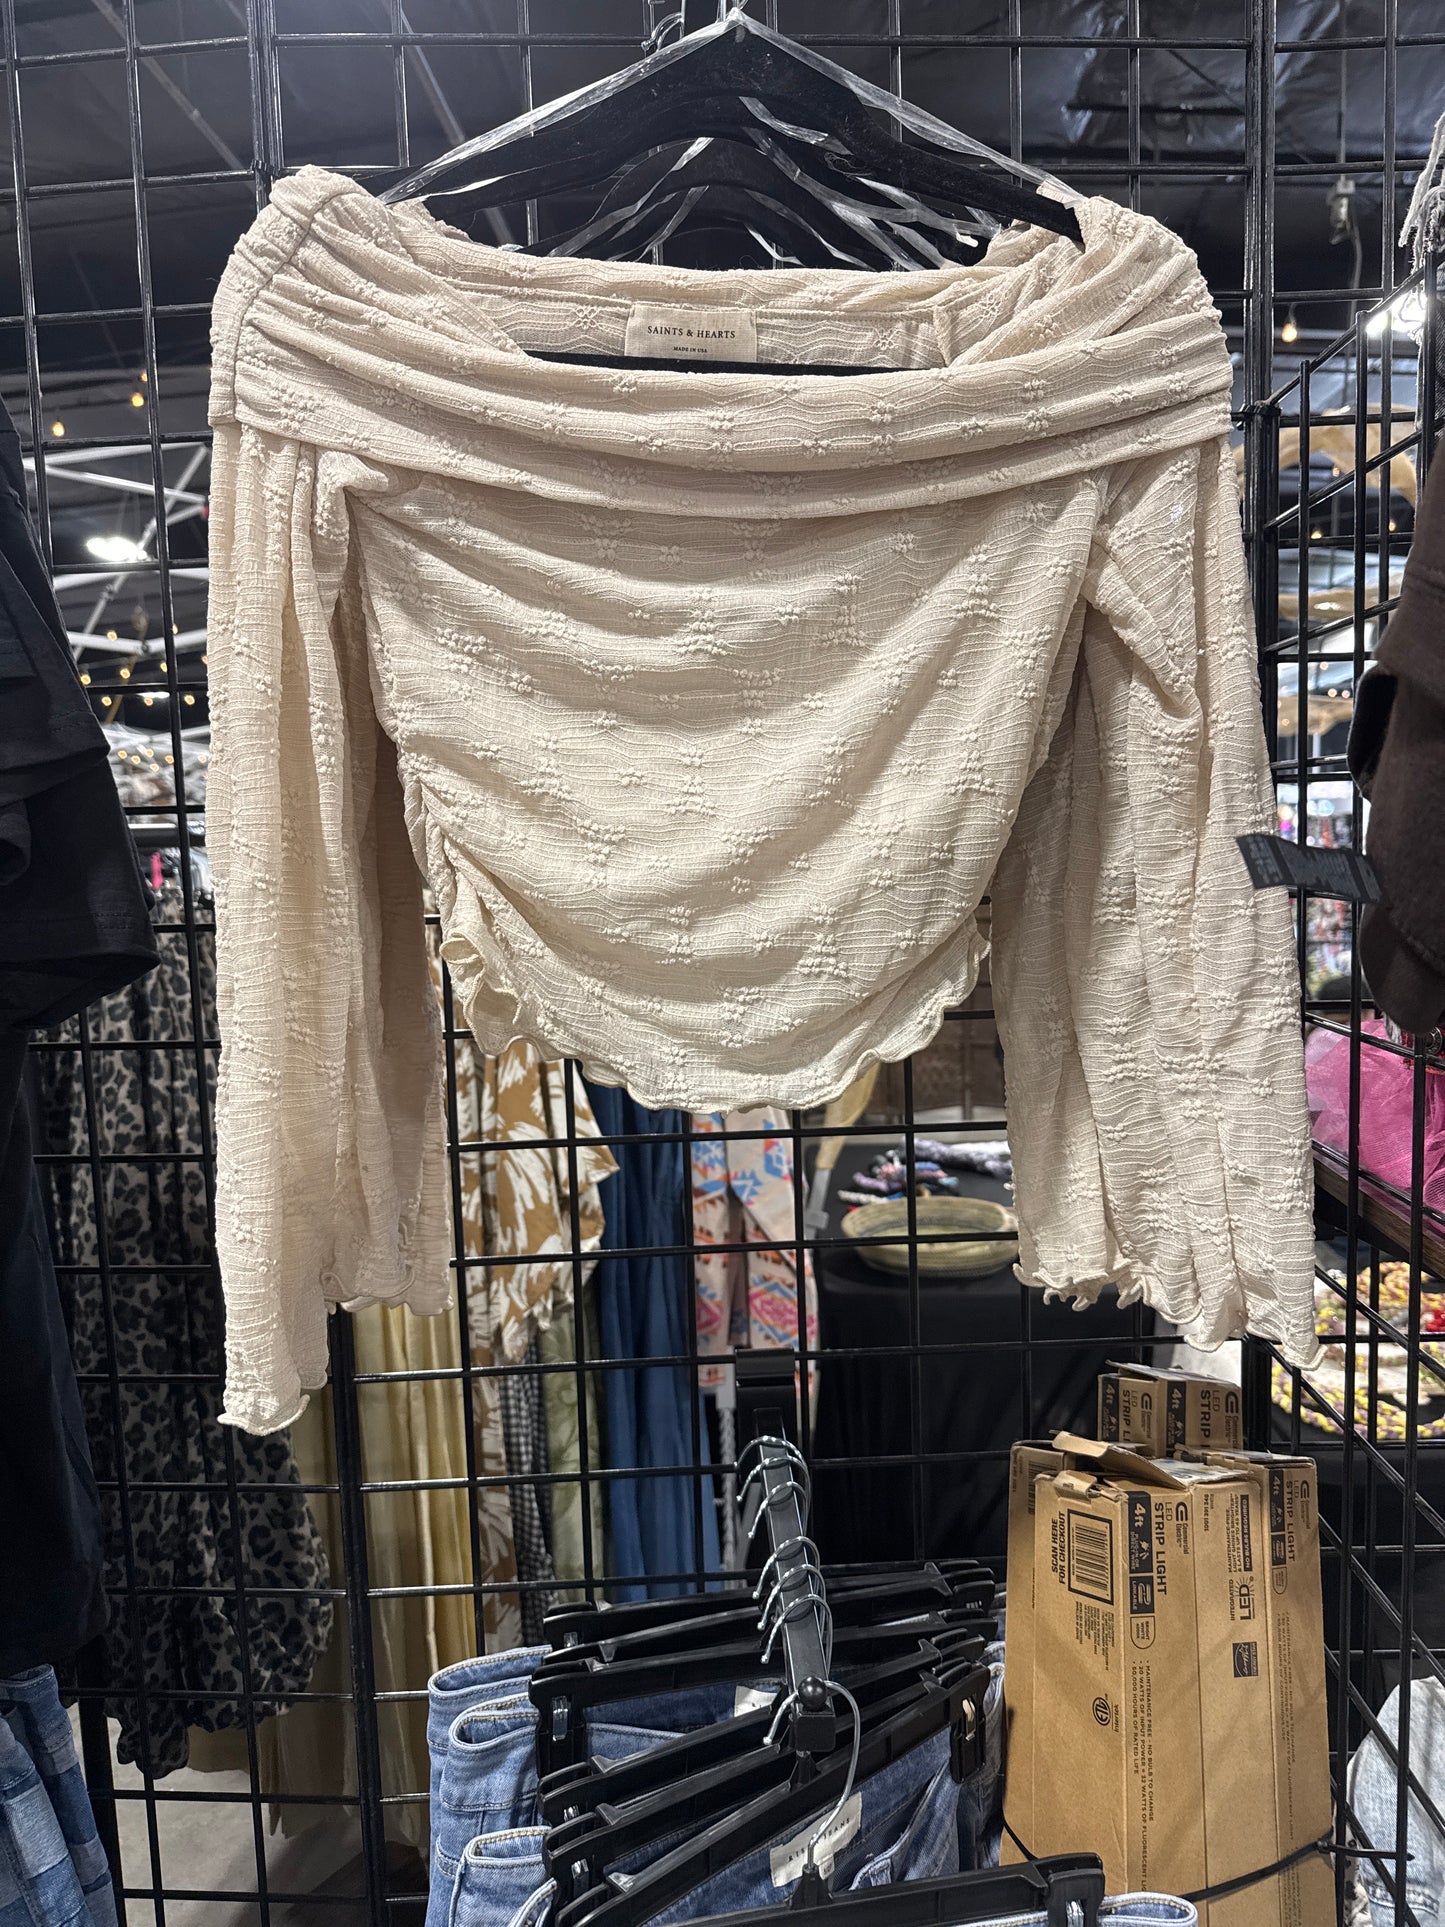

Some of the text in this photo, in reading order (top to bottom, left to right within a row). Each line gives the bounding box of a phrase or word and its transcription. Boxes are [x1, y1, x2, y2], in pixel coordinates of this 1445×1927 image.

[647, 326, 736, 339] SAINTS & HEARTS
[1106, 1384, 1115, 1405] 4ft
[1171, 1388, 1182, 1409] 4ft
[1212, 1390, 1220, 1412] LED
[1123, 1390, 1131, 1426] STRIP
[1200, 1390, 1211, 1438] STRIP
[1273, 1476, 1281, 1496] 4ft
[1134, 1503, 1146, 1527] 4ft
[1165, 1502, 1173, 1521] LED
[1286, 1480, 1295, 1562] STRIP LIGHT
[1155, 1502, 1167, 1595] STRIP LIGHT
[1182, 1523, 1190, 1554] Commercial
[1245, 1557, 1250, 1568] NO
[1238, 1584, 1251, 1620] LED
[1139, 1666, 1144, 1675] 20
[1140, 1704, 1145, 1714] OF
[1133, 1720, 1138, 1730] OF
[1147, 1745, 1153, 1755] NO
[1148, 1778, 1153, 1789] TO
[823, 1817, 850, 1839] JEANS
[1142, 1813, 1147, 1823] OF
